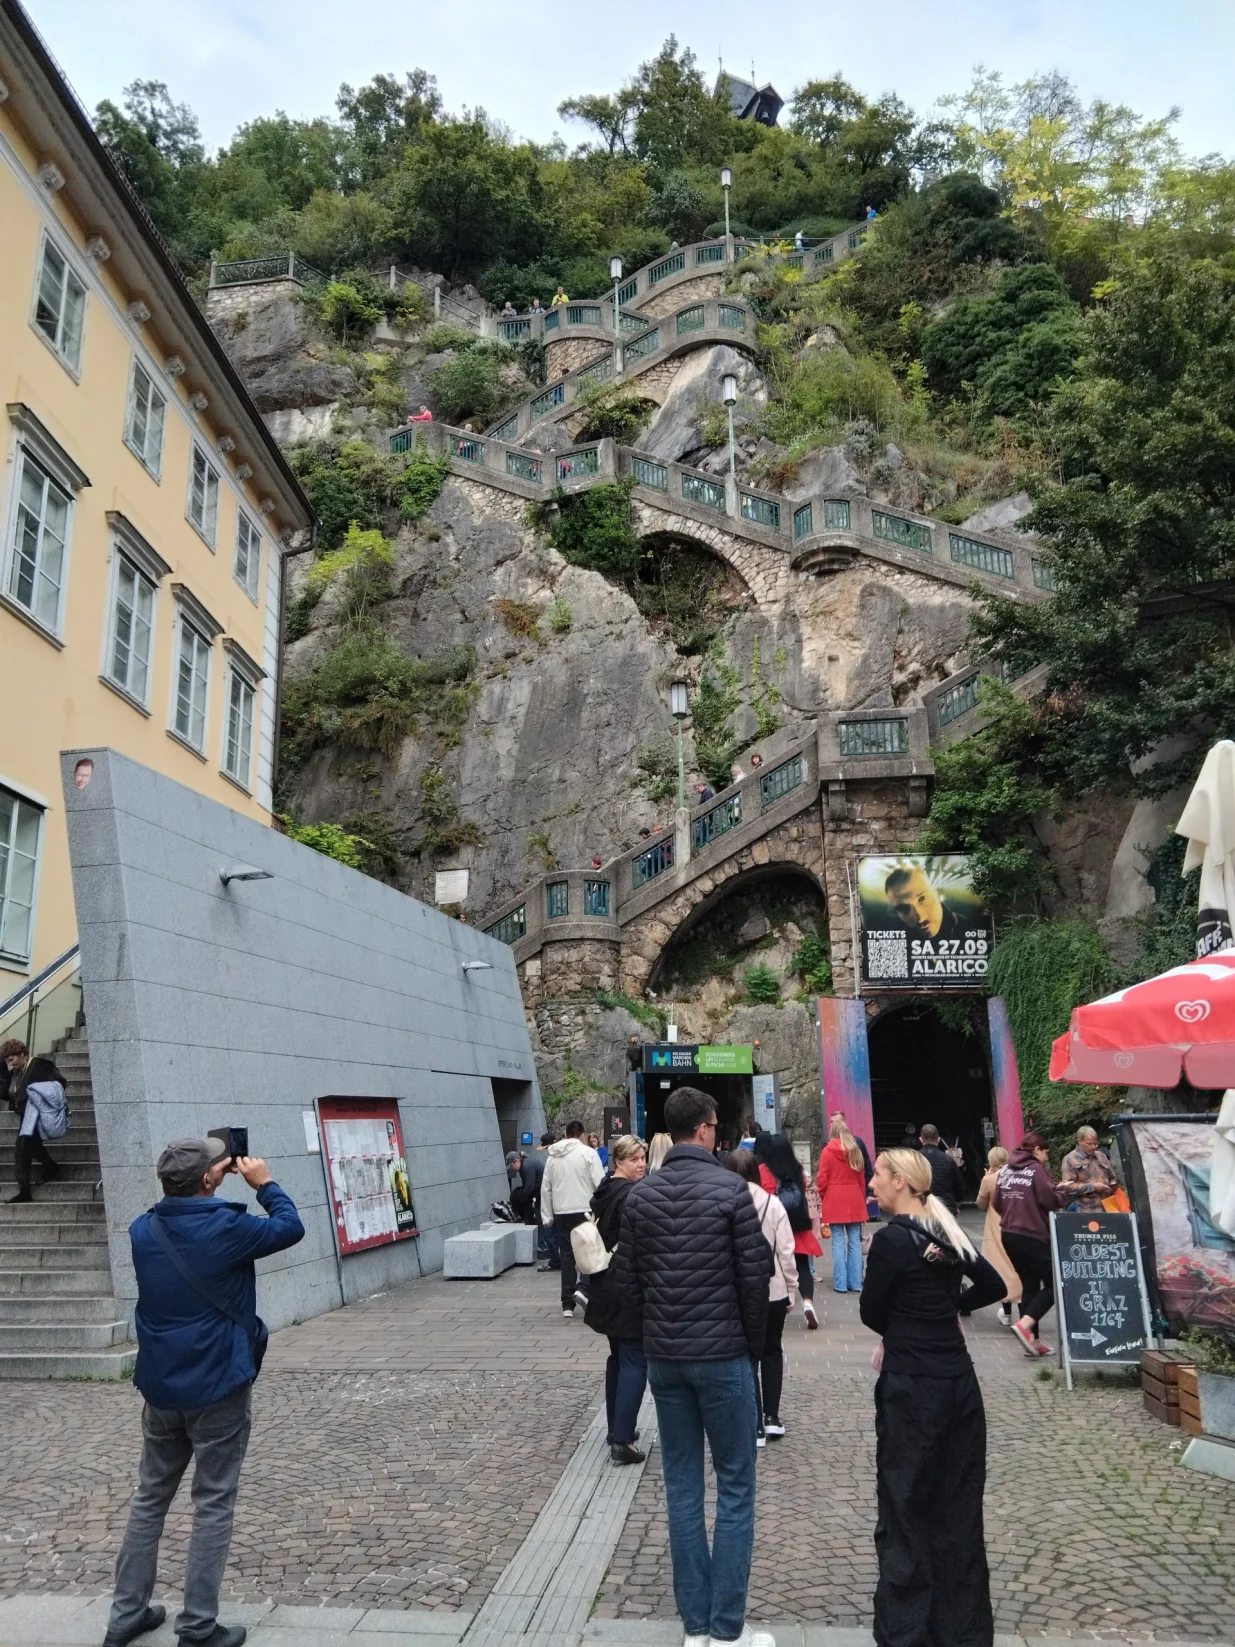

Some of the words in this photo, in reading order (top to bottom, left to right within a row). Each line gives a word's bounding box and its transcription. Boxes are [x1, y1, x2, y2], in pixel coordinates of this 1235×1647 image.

[867, 930, 906, 939] TICKETS
[911, 940, 935, 955] SA
[938, 939, 988, 955] 27.09
[912, 959, 988, 974] ALARICO
[672, 1059, 692, 1067] BAHN
[1069, 1243, 1129, 1260] OLDEST
[1062, 1259, 1136, 1279] BUILDING
[1079, 1294, 1128, 1311] GRAZ
[1090, 1312, 1125, 1329] 1164
